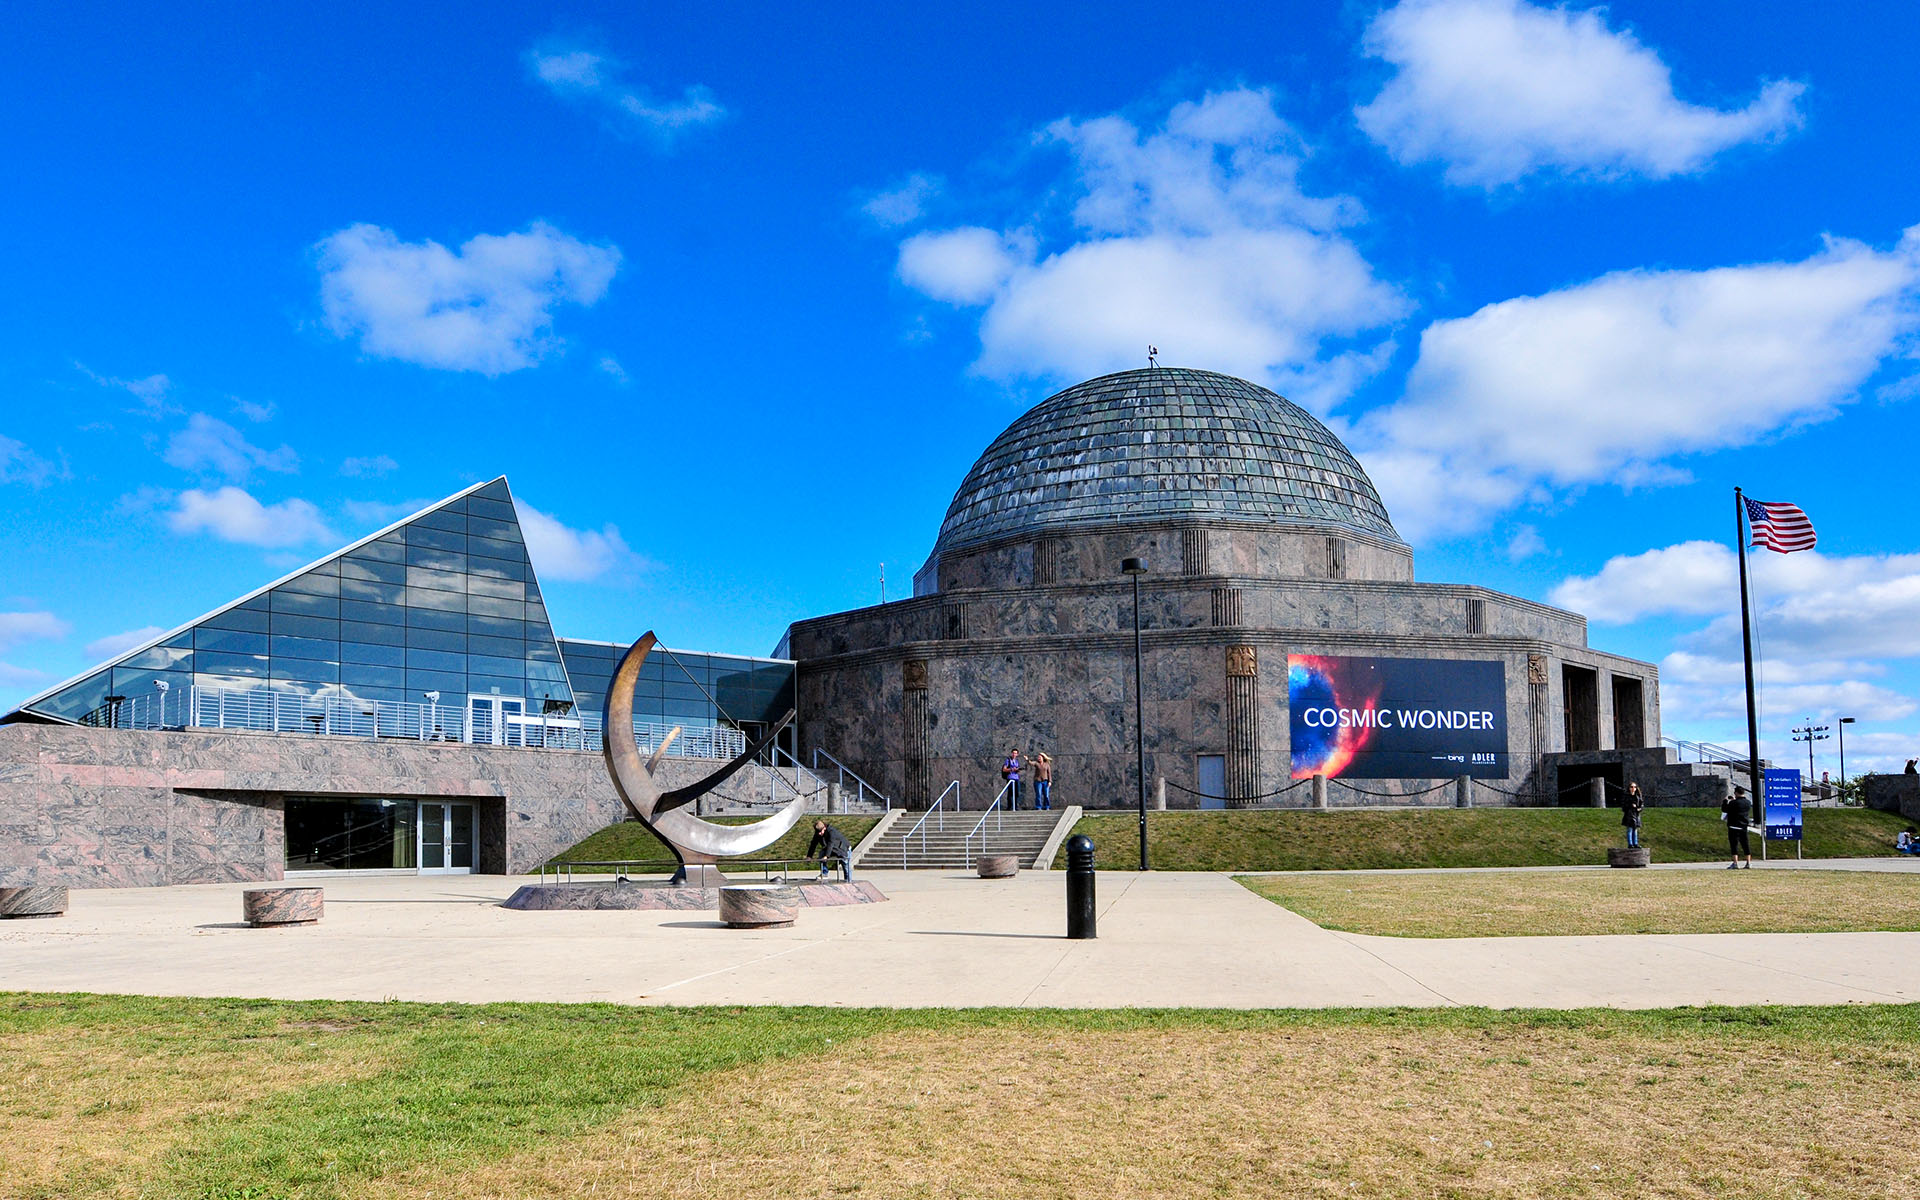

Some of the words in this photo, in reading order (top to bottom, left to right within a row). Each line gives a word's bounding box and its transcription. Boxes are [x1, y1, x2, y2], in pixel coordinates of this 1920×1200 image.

[1303, 707, 1393, 729] COSMIC
[1396, 709, 1495, 730] WONDER
[1447, 754, 1465, 763] bing
[1471, 752, 1496, 761] ADLER
[1775, 827, 1793, 835] ADLER
